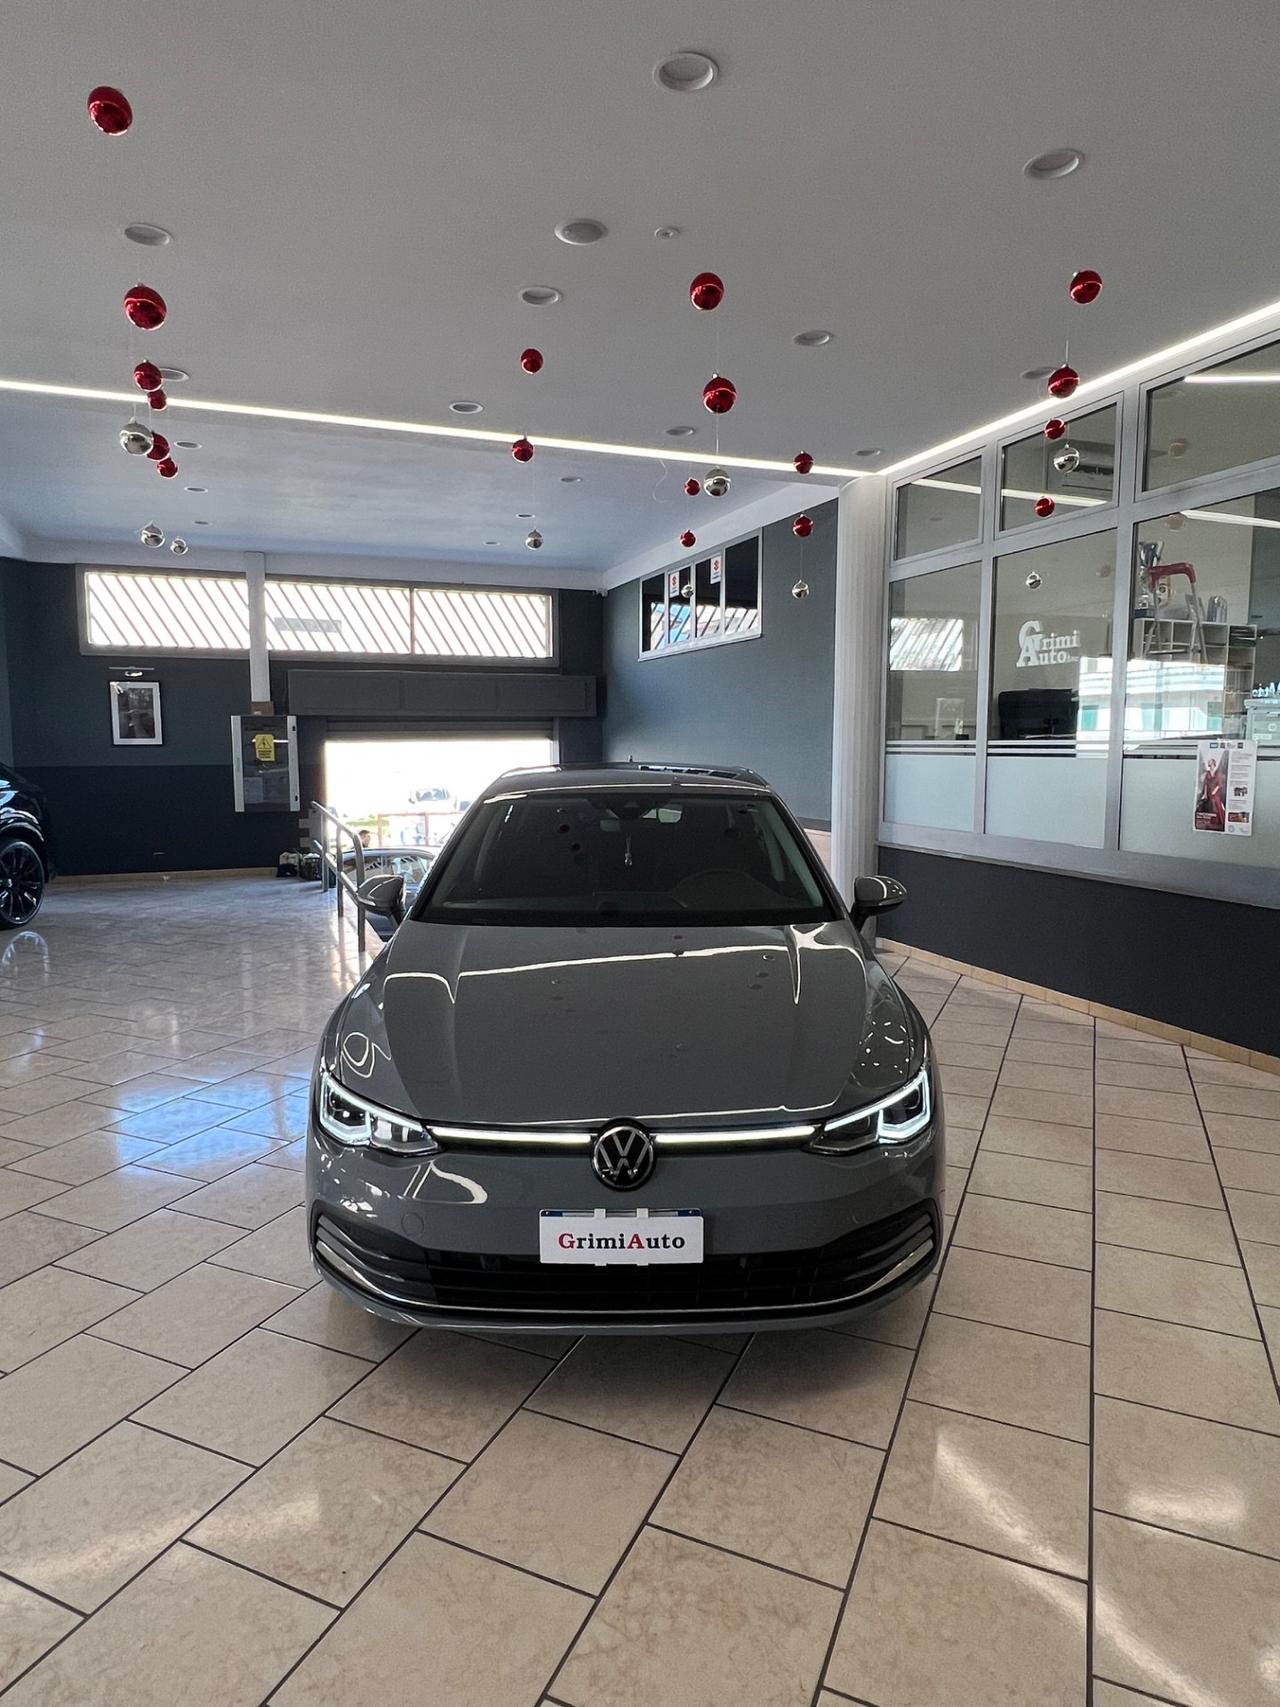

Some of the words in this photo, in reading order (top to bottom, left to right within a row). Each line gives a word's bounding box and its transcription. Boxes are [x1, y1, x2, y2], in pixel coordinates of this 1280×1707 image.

[1019, 620, 1080, 651] Grimi
[1016, 636, 1067, 667] Auto
[558, 1233, 686, 1249] GrimiAuto
